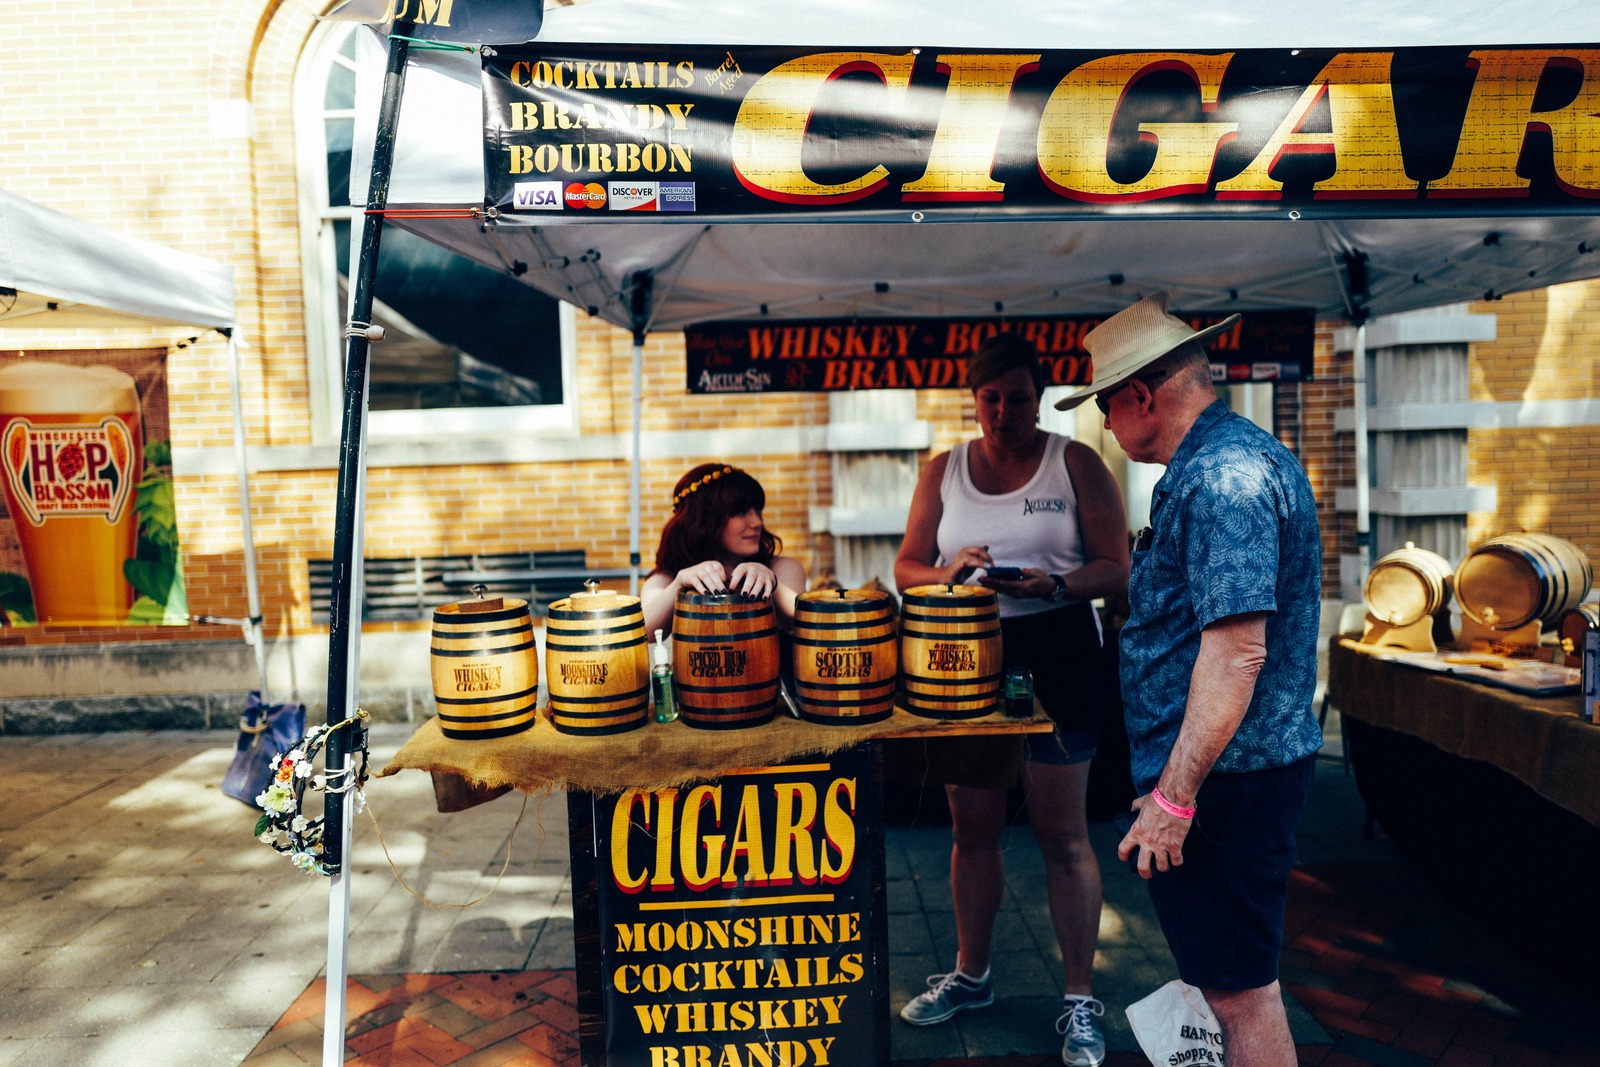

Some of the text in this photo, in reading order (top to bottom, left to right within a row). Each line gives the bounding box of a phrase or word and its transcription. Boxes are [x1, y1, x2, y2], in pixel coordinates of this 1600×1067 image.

[510, 60, 694, 89] COCKTAILS
[704, 51, 735, 87] Barrel
[719, 63, 743, 95] Aged
[509, 101, 694, 132] BRANDY
[731, 50, 1600, 205] CIGAR
[508, 142, 694, 174] BOURBON
[518, 190, 557, 205] VISA
[565, 192, 606, 201] MasterCard
[612, 187, 653, 196] DISCOVER
[747, 324, 918, 361] WHISKEY
[30, 442, 107, 482] HOP
[34, 483, 110, 501] BLOSSOM
[689, 650, 747, 668] SPICED RUM
[816, 651, 873, 668] SCOTCH
[929, 649, 974, 662] WHISKEY
[453, 666, 501, 682] WHISKEY
[560, 663, 608, 677] MOONSHINE
[691, 667, 744, 677] CIGARS
[818, 667, 871, 678] CIGARS
[928, 661, 976, 671] CIGARS
[456, 682, 501, 692] CIGARS
[563, 676, 606, 685] CIGARS
[611, 777, 857, 894] CIGARS
[614, 912, 861, 953] MOONSHINE
[613, 953, 864, 994] COCKTAILS
[633, 995, 848, 1034] WHISKEY
[649, 1036, 836, 1067] BRANDY
